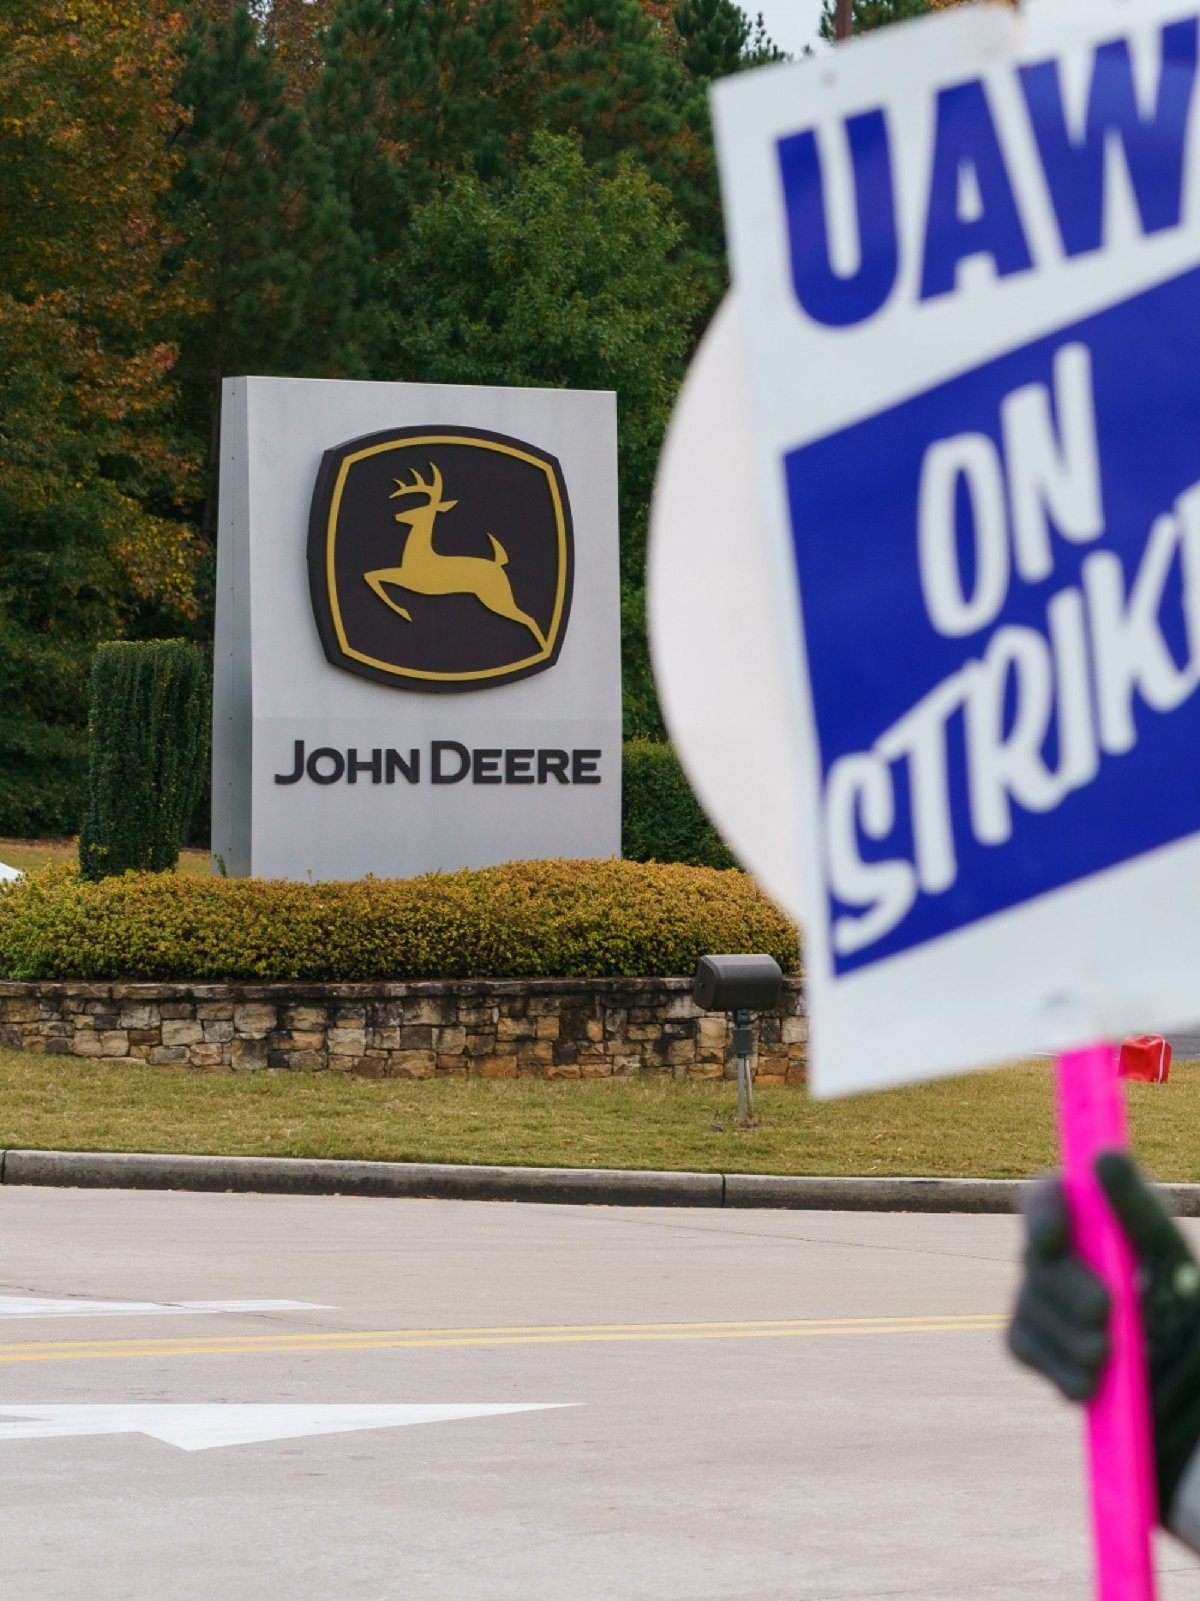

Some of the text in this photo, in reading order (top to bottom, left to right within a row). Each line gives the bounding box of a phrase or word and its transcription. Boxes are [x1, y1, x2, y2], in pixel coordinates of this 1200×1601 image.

[917, 341, 1104, 638] ON
[274, 739, 602, 785] JOHN DEERE
